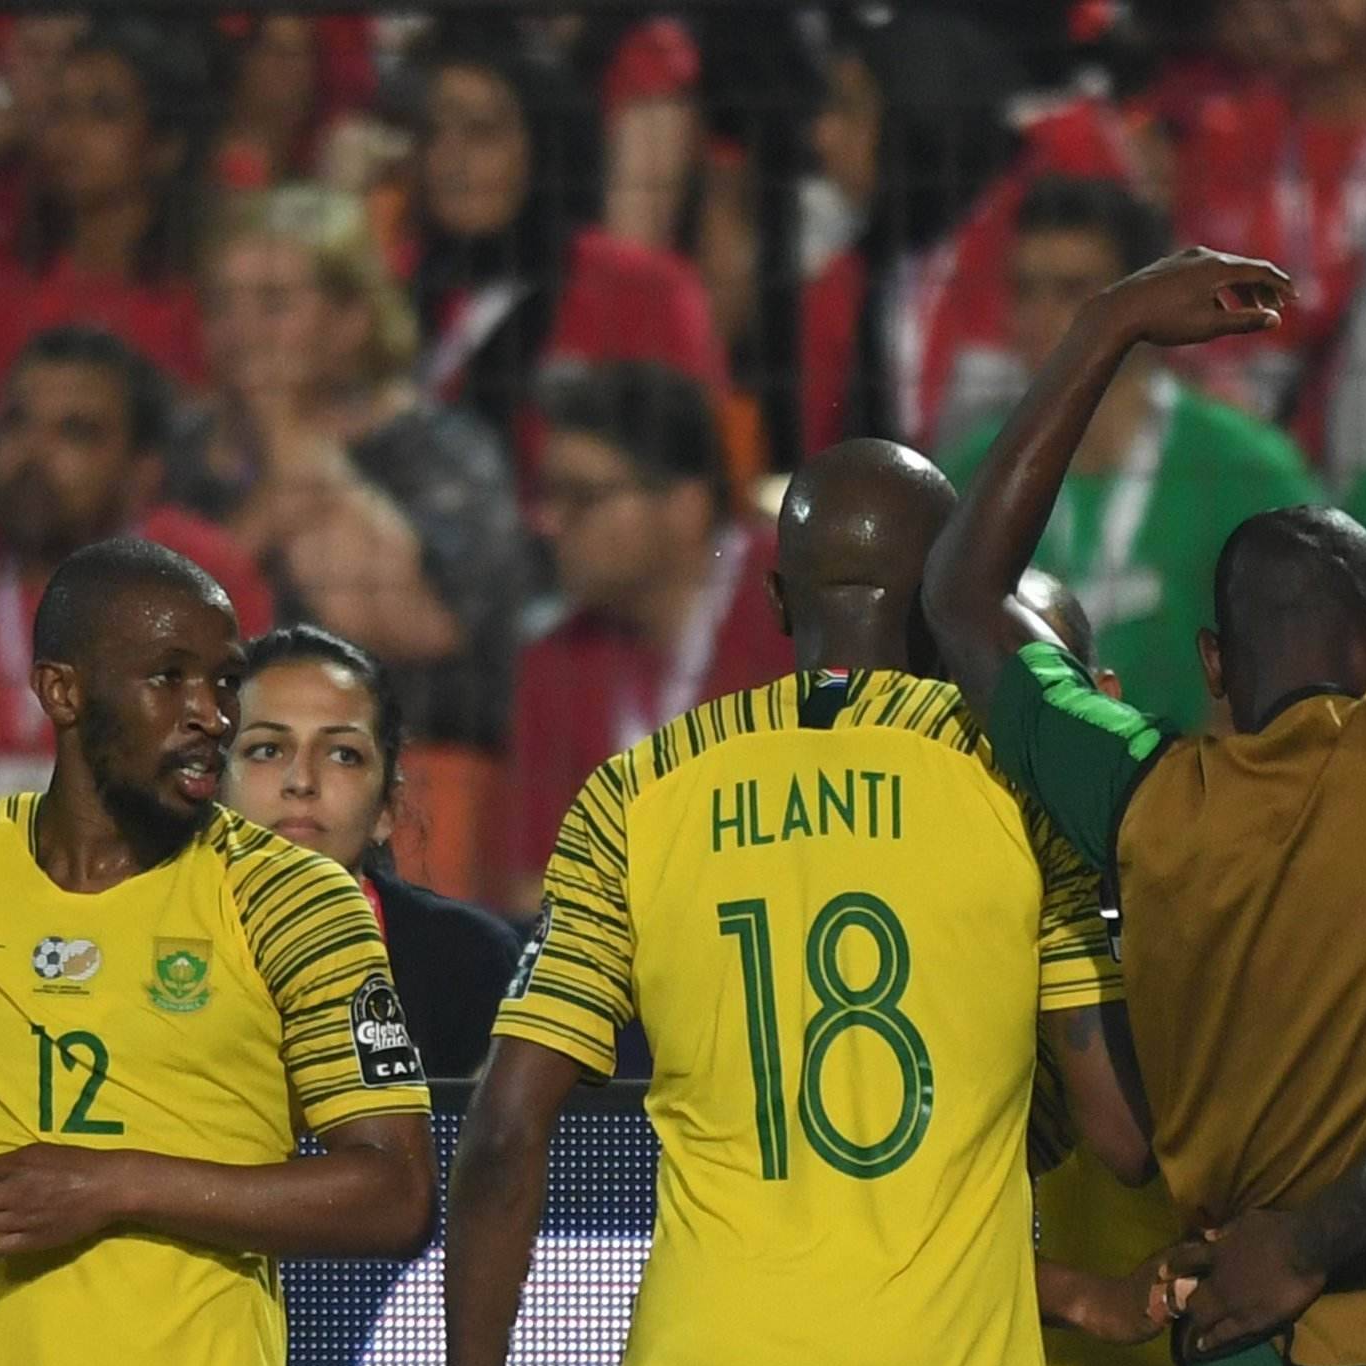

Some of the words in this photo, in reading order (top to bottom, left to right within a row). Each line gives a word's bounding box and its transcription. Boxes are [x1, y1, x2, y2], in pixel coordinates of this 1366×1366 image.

[711, 767, 903, 853] HLANTI
[30, 1024, 125, 1136] 12
[717, 891, 934, 1181] 18
